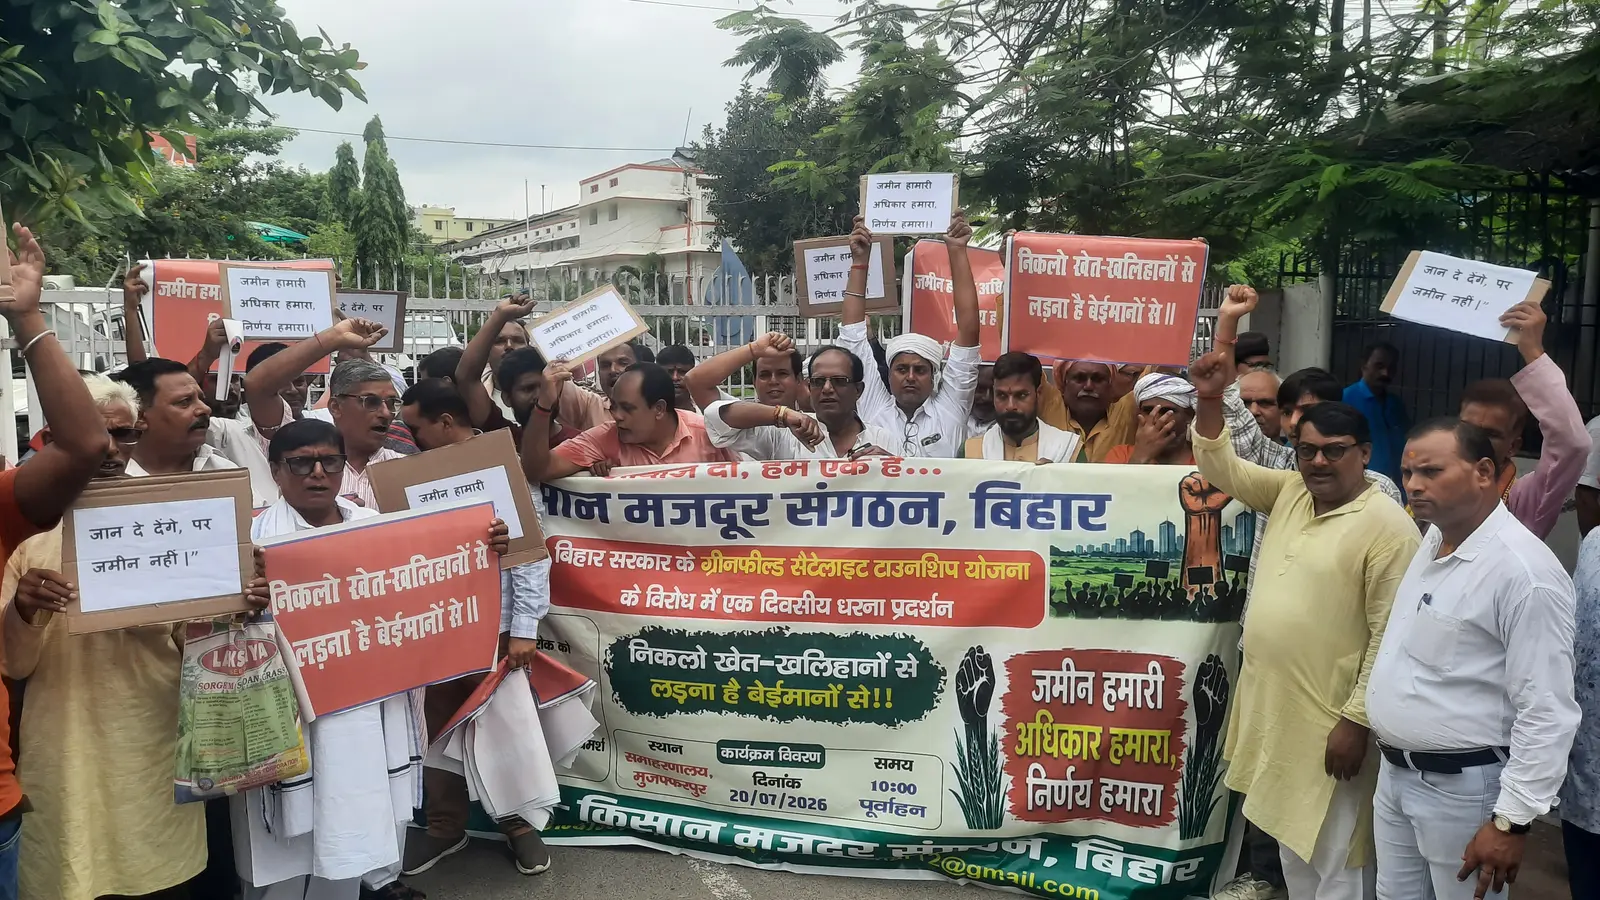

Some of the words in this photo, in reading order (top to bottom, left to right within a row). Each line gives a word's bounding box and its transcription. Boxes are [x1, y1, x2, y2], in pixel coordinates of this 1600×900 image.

[876, 180, 900, 190] जमीन
[873, 200, 906, 210] अधिकार
[871, 218, 897, 229] निर्णय
[813, 253, 835, 263] जमीन
[1017, 247, 1069, 277] निकलो
[1073, 250, 1178, 282] खेत-खलिहानों
[1180, 255, 1197, 283] से
[240, 277, 269, 289] जमीन
[813, 271, 843, 281] अधिकार
[915, 271, 945, 293] जमीन
[1423, 265, 1448, 278] जान
[1452, 269, 1463, 281] दे
[1467, 271, 1488, 287] देंगे,
[1496, 279, 1513, 290] पर
[157, 277, 197, 299] जमीन
[815, 289, 837, 300] निर्णय
[1412, 285, 1447, 301] जमीन
[239, 298, 280, 310] अधिकार
[351, 301, 367, 312] देंगे,
[372, 304, 384, 312] पर
[1027, 295, 1069, 324] लड़ना
[1072, 294, 1085, 321] है
[1088, 294, 1145, 325] बेईमानों
[242, 320, 271, 333] निर्णय
[543, 319, 568, 335] जमीन
[548, 327, 581, 349] अधिकार
[555, 345, 582, 361] निर्णय
[760, 460, 811, 479] हम
[819, 458, 872, 478] एक
[418, 487, 449, 503] जमीन
[617, 492, 773, 540] मजदूर
[780, 482, 957, 535] संगठन,
[969, 480, 1112, 531] बिहार
[89, 526, 124, 541] जान
[133, 521, 144, 537] दे
[153, 518, 182, 536] देंगे,
[192, 518, 212, 531] पर
[92, 554, 140, 574] जमीन
[555, 539, 606, 567] बिहार
[608, 549, 671, 572] सरकार
[675, 550, 695, 573] के
[700, 549, 786, 577] ग्रीनफील्ड
[790, 550, 868, 578] सैटेलाइट
[873, 552, 960, 580] टाउनशिप
[964, 554, 1031, 581] योजना
[269, 573, 341, 616] निकलो
[346, 543, 470, 600] खेत-खलिहानों
[473, 540, 489, 570] से
[620, 583, 641, 606] के
[645, 583, 696, 611] विरोध
[700, 587, 722, 613] में
[722, 593, 756, 614] एक
[759, 588, 833, 616] दिवसीय
[837, 598, 886, 618] धरना
[891, 592, 954, 621] प्रदर्शन
[292, 628, 351, 670] लड़ना
[353, 619, 370, 651] है
[375, 610, 444, 648] बेईमानों
[558, 639, 571, 654] को
[628, 638, 707, 670] निकलो
[712, 645, 892, 680] खेत-खलिहानों
[894, 652, 919, 678] से
[650, 678, 716, 705] लड़ना
[721, 677, 740, 702] है
[746, 679, 844, 708] बेईमानों
[846, 685, 893, 710] से!!
[1031, 657, 1096, 706] जमीन
[1101, 660, 1165, 713] हमारी
[648, 740, 683, 755] स्थान
[1014, 708, 1102, 761] अधिकार
[1109, 727, 1176, 770] हमारा,
[721, 746, 774, 762] कार्यक्रम
[778, 748, 821, 764] विवरण
[873, 756, 914, 773] समय
[752, 772, 802, 790] दिनांक
[870, 779, 918, 796] 10:00
[1025, 762, 1093, 812] निर्णय
[1099, 776, 1164, 816] हमारा
[729, 788, 828, 811] 20/07/2026
[576, 795, 729, 843] किसान
[1071, 840, 1205, 885] बिहार
